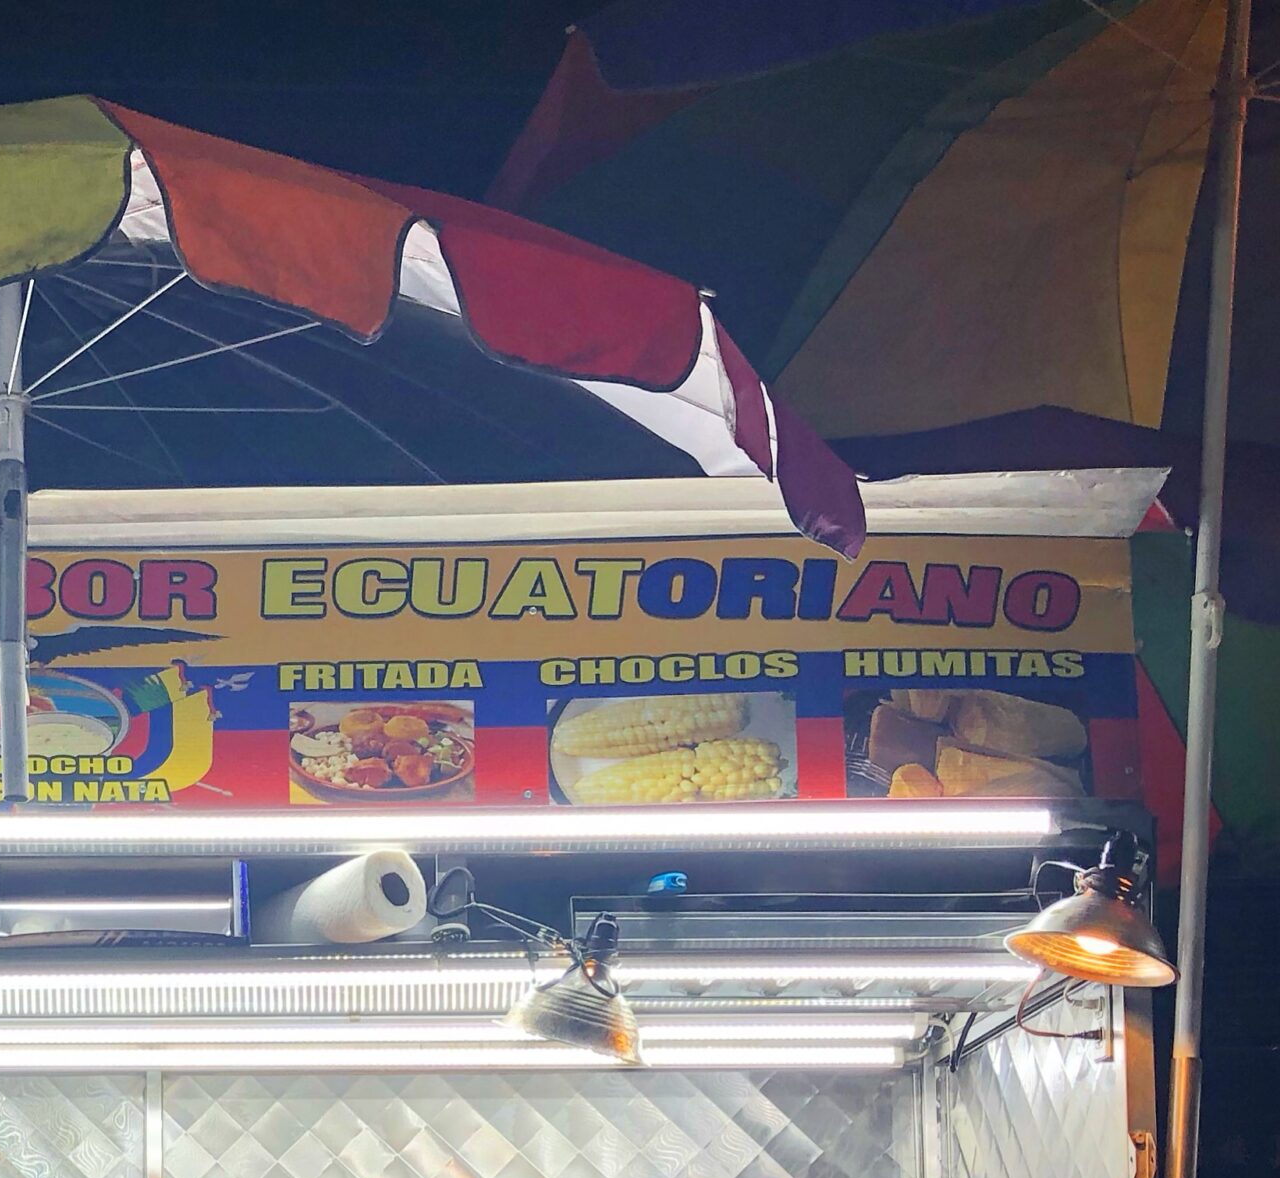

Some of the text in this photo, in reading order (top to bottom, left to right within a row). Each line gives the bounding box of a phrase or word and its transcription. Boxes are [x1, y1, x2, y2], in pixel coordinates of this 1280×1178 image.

[260, 556, 1083, 632] ECUATORIANO
[277, 658, 485, 691] FRITADA
[538, 650, 800, 686] CHOCLOS
[842, 648, 1087, 681] HUMITAS
[72, 779, 173, 803] NATA
